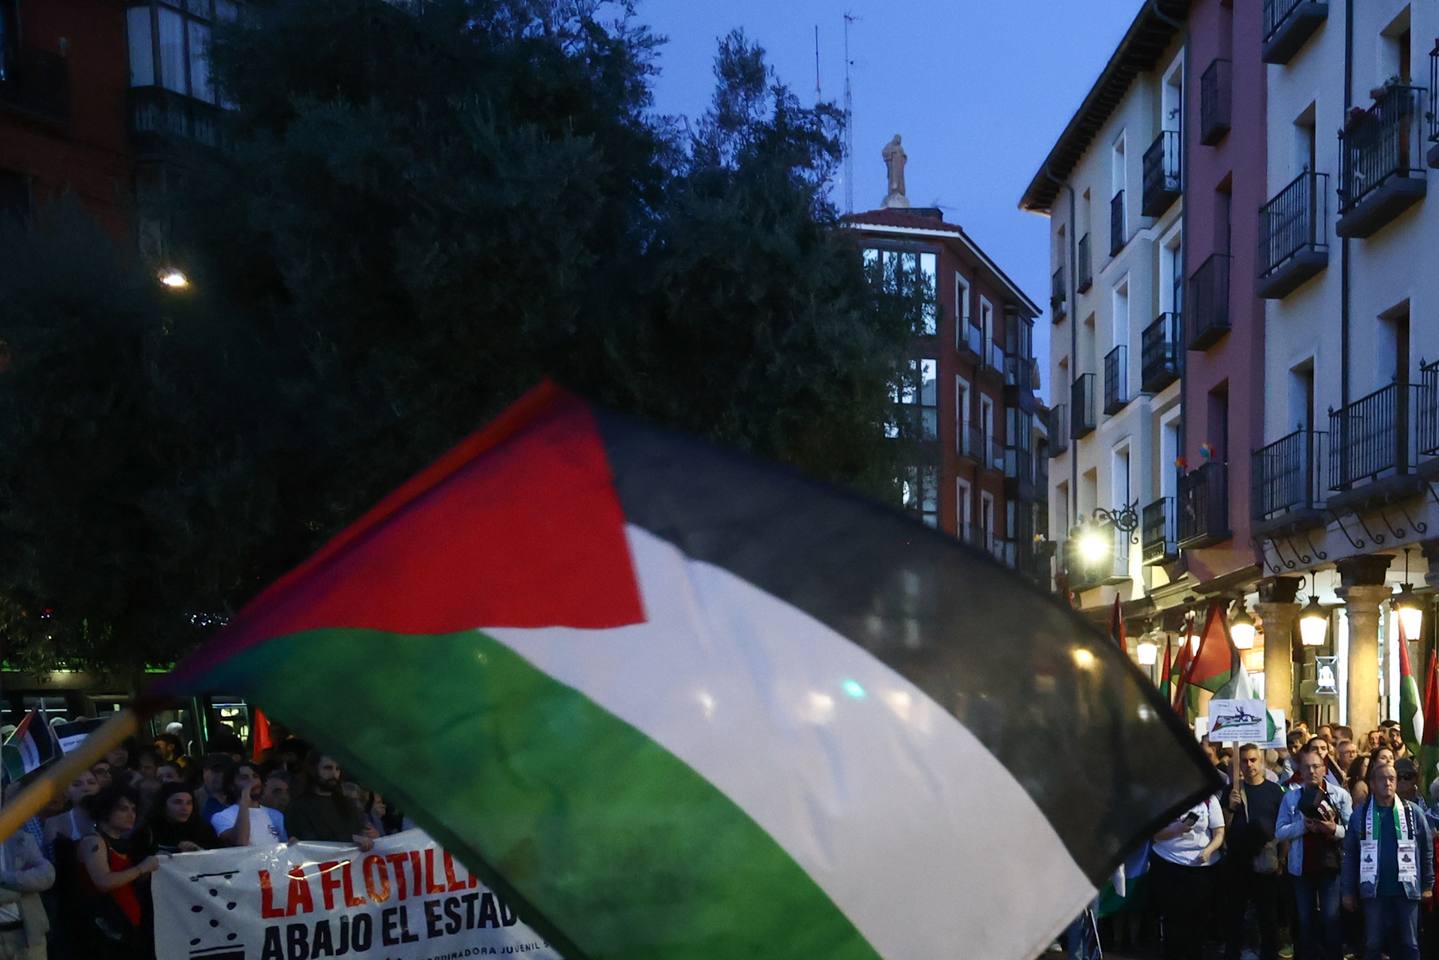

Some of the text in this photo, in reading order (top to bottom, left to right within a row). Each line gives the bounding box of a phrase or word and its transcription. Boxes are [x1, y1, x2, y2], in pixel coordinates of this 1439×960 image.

[258, 865, 314, 919] LA
[382, 905, 419, 947] EL
[500, 942, 541, 955] JUVENIL
